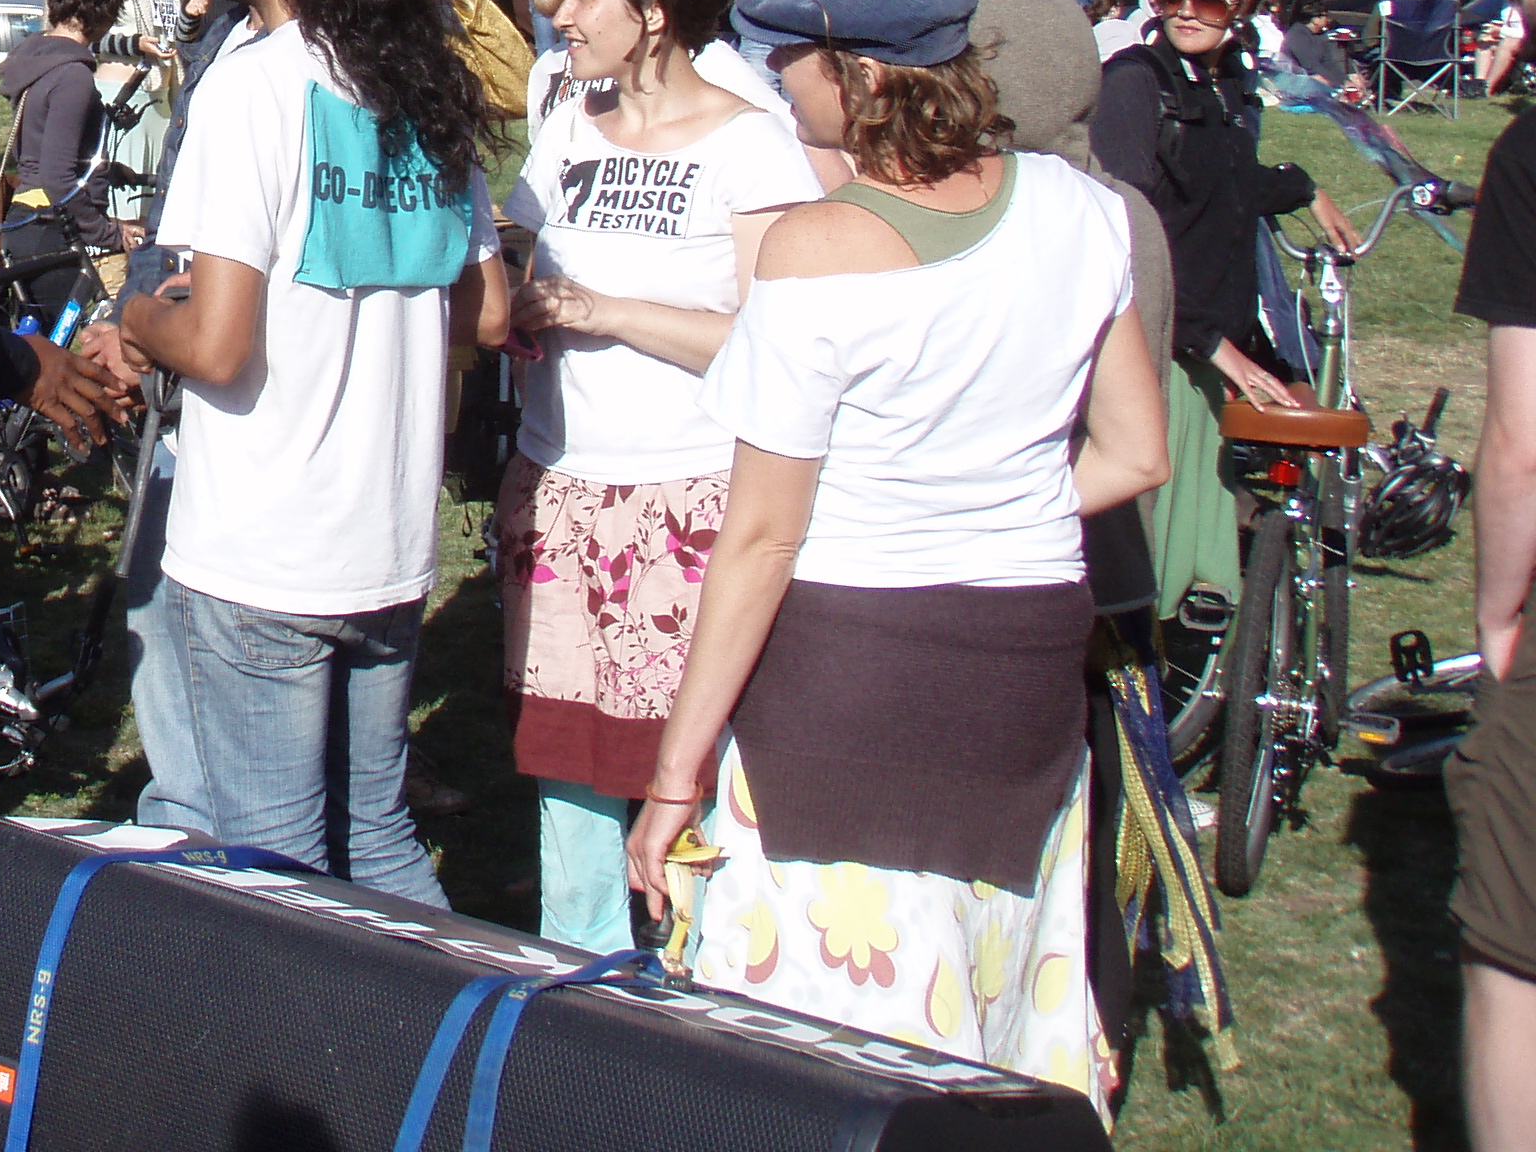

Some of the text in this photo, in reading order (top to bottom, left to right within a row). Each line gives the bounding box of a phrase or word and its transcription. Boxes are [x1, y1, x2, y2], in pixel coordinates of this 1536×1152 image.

[601, 156, 700, 189] BICYCLE
[315, 161, 454, 214] CO-DECTO
[594, 189, 687, 215] MUSIC
[587, 210, 682, 236] FESTIVAL
